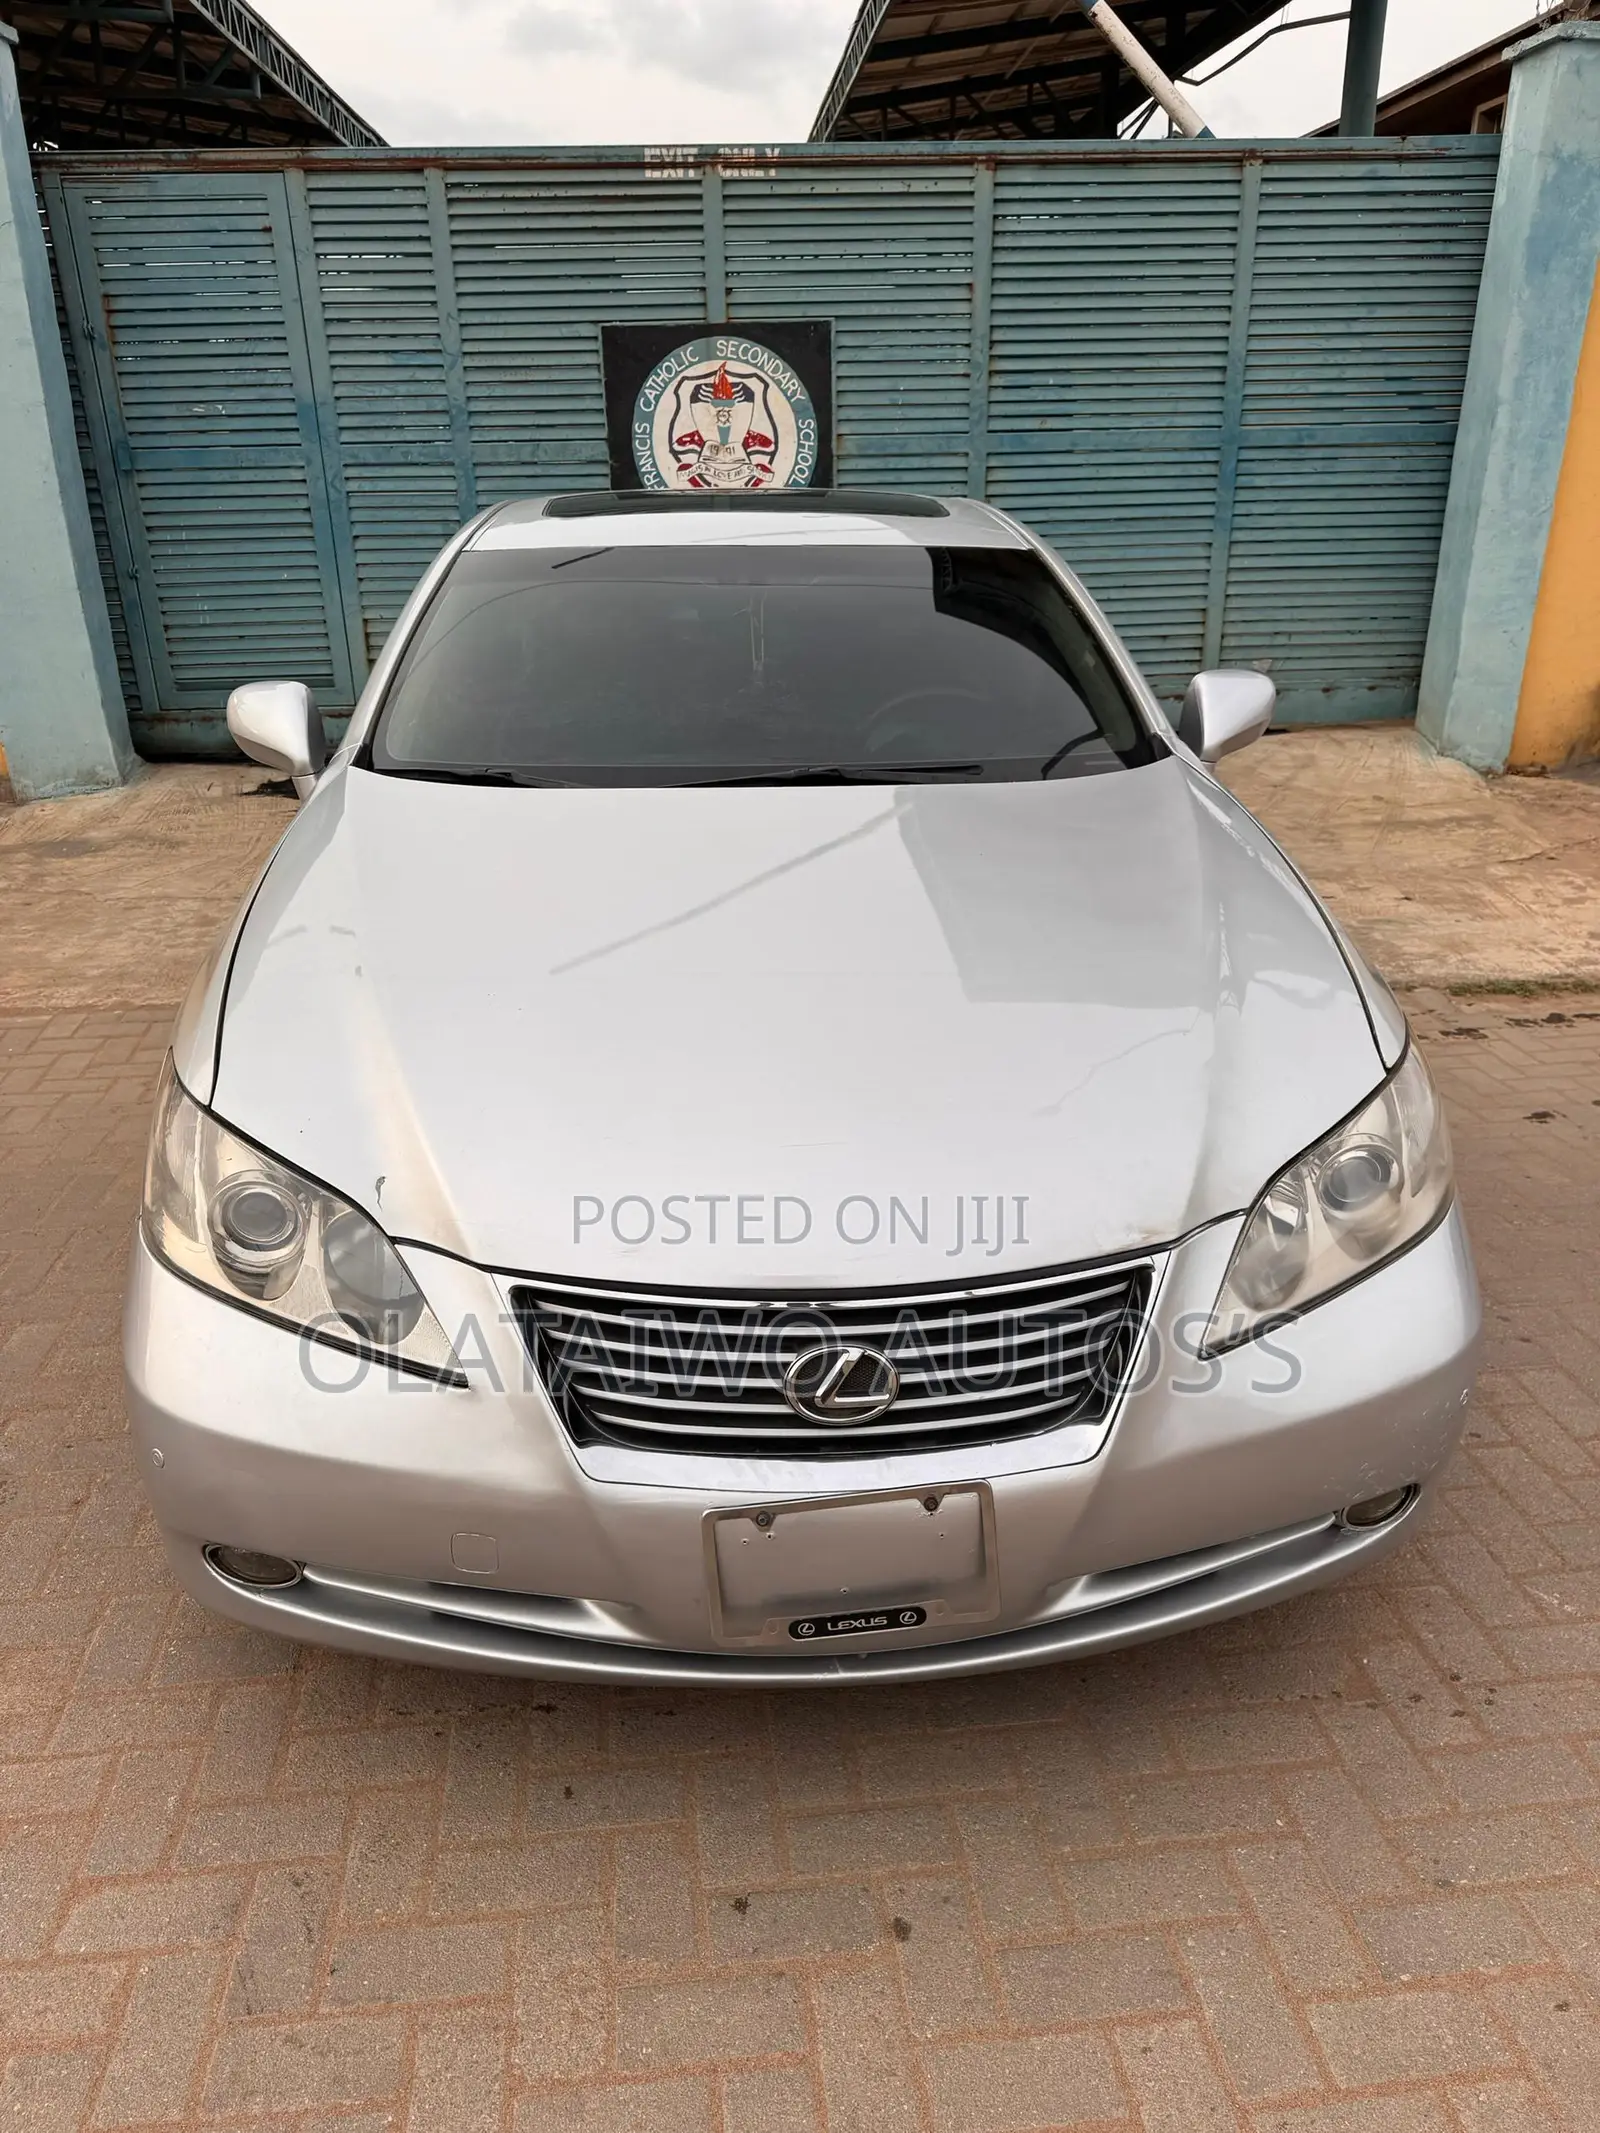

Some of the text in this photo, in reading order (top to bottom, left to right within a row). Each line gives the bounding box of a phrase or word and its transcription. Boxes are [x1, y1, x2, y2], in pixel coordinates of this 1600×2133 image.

[644, 147, 781, 178] EXIT ONLY
[639, 346, 699, 412] CATHOLIC
[716, 339, 806, 403] SECONDARY
[788, 418, 814, 485] SCHOOL
[827, 1616, 888, 1631] LEXUS
